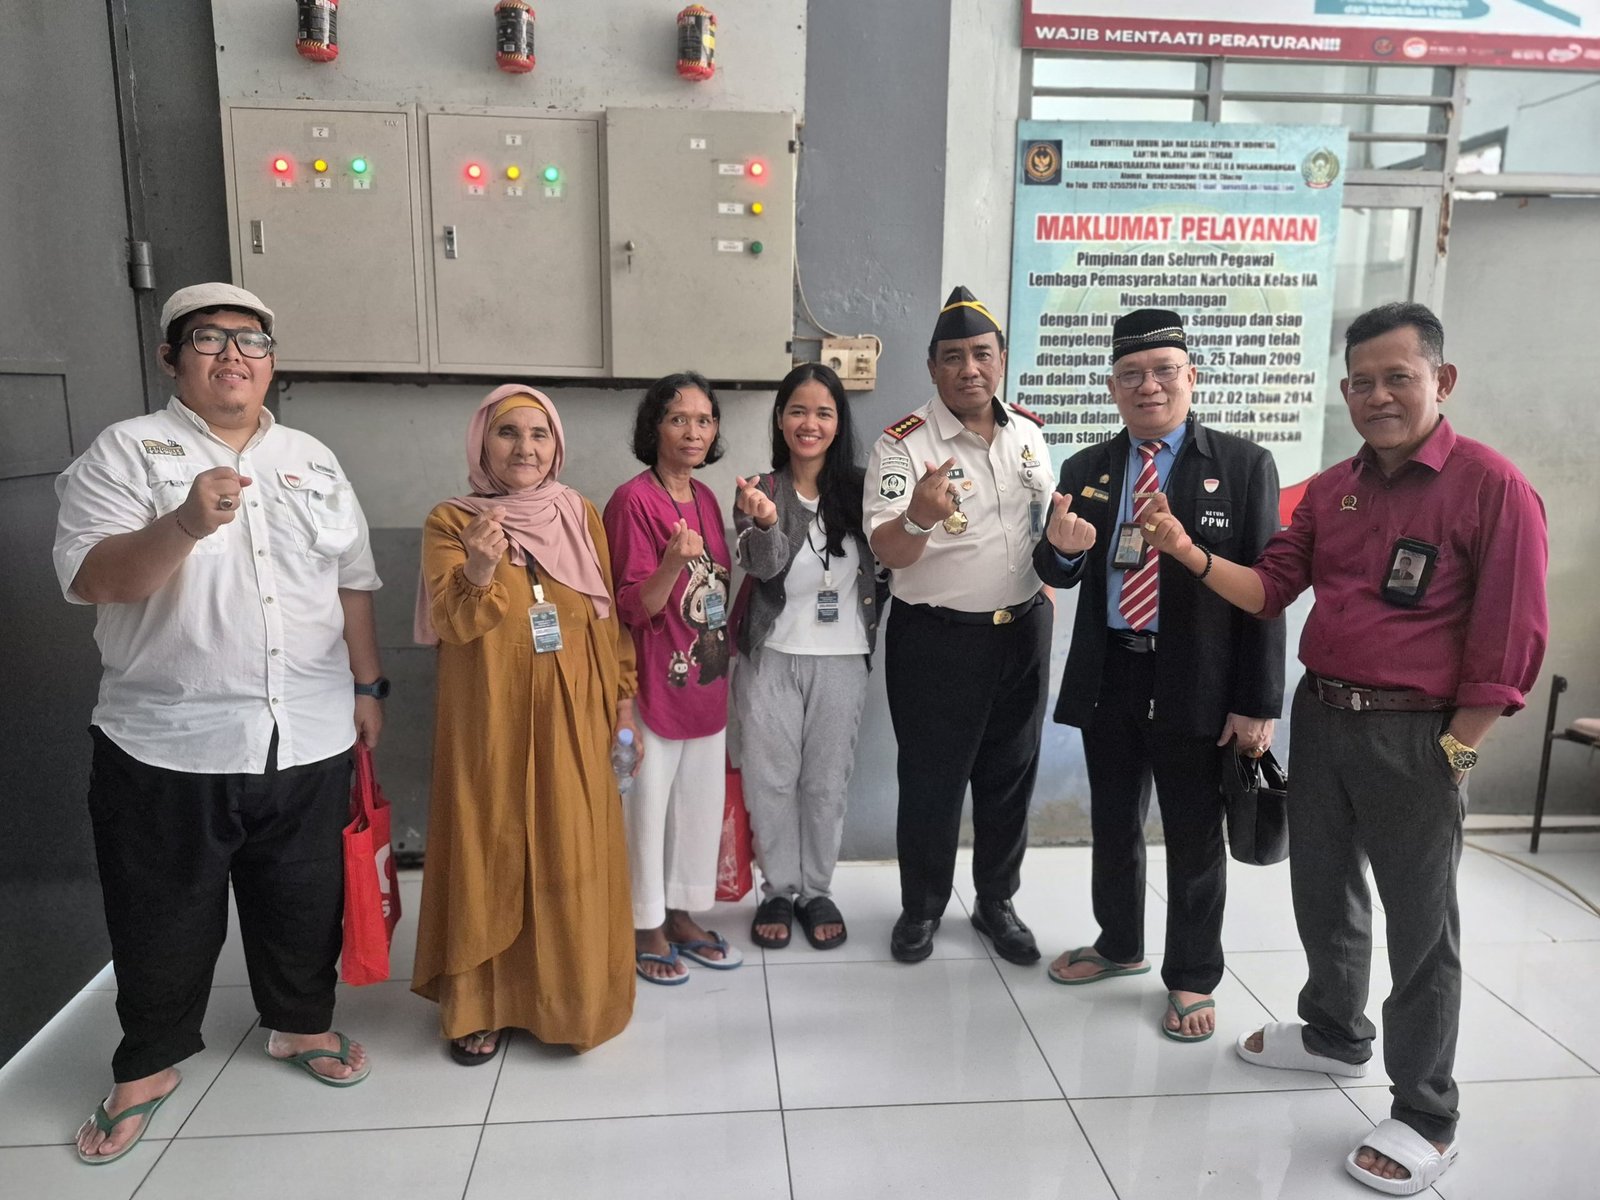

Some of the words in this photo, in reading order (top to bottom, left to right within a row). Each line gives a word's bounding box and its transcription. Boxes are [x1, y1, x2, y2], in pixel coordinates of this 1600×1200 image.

[1035, 26, 1099, 41] WAJIB
[1105, 29, 1203, 46] MENTAATI
[1208, 33, 1341, 52] PERATURAN!!!
[1066, 161, 1098, 169] LEMBAGA
[1100, 161, 1160, 170] PEMASYARAKATAN
[1036, 215, 1172, 241] MAKLUMAT
[1180, 216, 1318, 242] PELAYANAN
[1076, 252, 1137, 268] Pimpinan
[1140, 252, 1165, 266] dan
[1168, 252, 1217, 267] Seluruh
[1220, 253, 1274, 269] Pegawai
[1029, 272, 1088, 288] Lembaga
[1090, 273, 1197, 289] Pemasyarakatan
[1200, 273, 1260, 287] Narkotika
[1264, 273, 1298, 287] Kelas
[1301, 273, 1318, 287] IIA
[1119, 293, 1227, 308] Nusakambangan
[1040, 313, 1086, 328] dengan
[1091, 313, 1108, 327] ini
[1192, 314, 1247, 328] sanggup
[1249, 313, 1272, 327] dan
[1275, 313, 1303, 328] siap
[1040, 333, 1114, 348] menyeleng
[1235, 334, 1265, 347] yang
[1268, 332, 1300, 346] telah
[1036, 353, 1105, 368] ditetapkan
[1189, 352, 1207, 366] No.
[1210, 352, 1225, 366] 25
[1229, 352, 1266, 366] Tahun
[1269, 352, 1301, 366] 2009
[1019, 372, 1043, 386] dan
[1046, 372, 1086, 386] dalam
[1196, 371, 1259, 385] Direktorat
[1261, 371, 1316, 385] Jenderal
[1017, 392, 1117, 406] Pemasyarakata
[1245, 391, 1281, 404] tahun
[1284, 391, 1312, 404] 2014
[1034, 411, 1078, 425] pabila
[1080, 411, 1119, 425] dalam
[1224, 410, 1256, 423] tidak
[1259, 411, 1300, 423] sesuai
[1043, 433, 1073, 445] ngan
[1076, 430, 1117, 444] standa
[1200, 516, 1230, 528] PPWI
